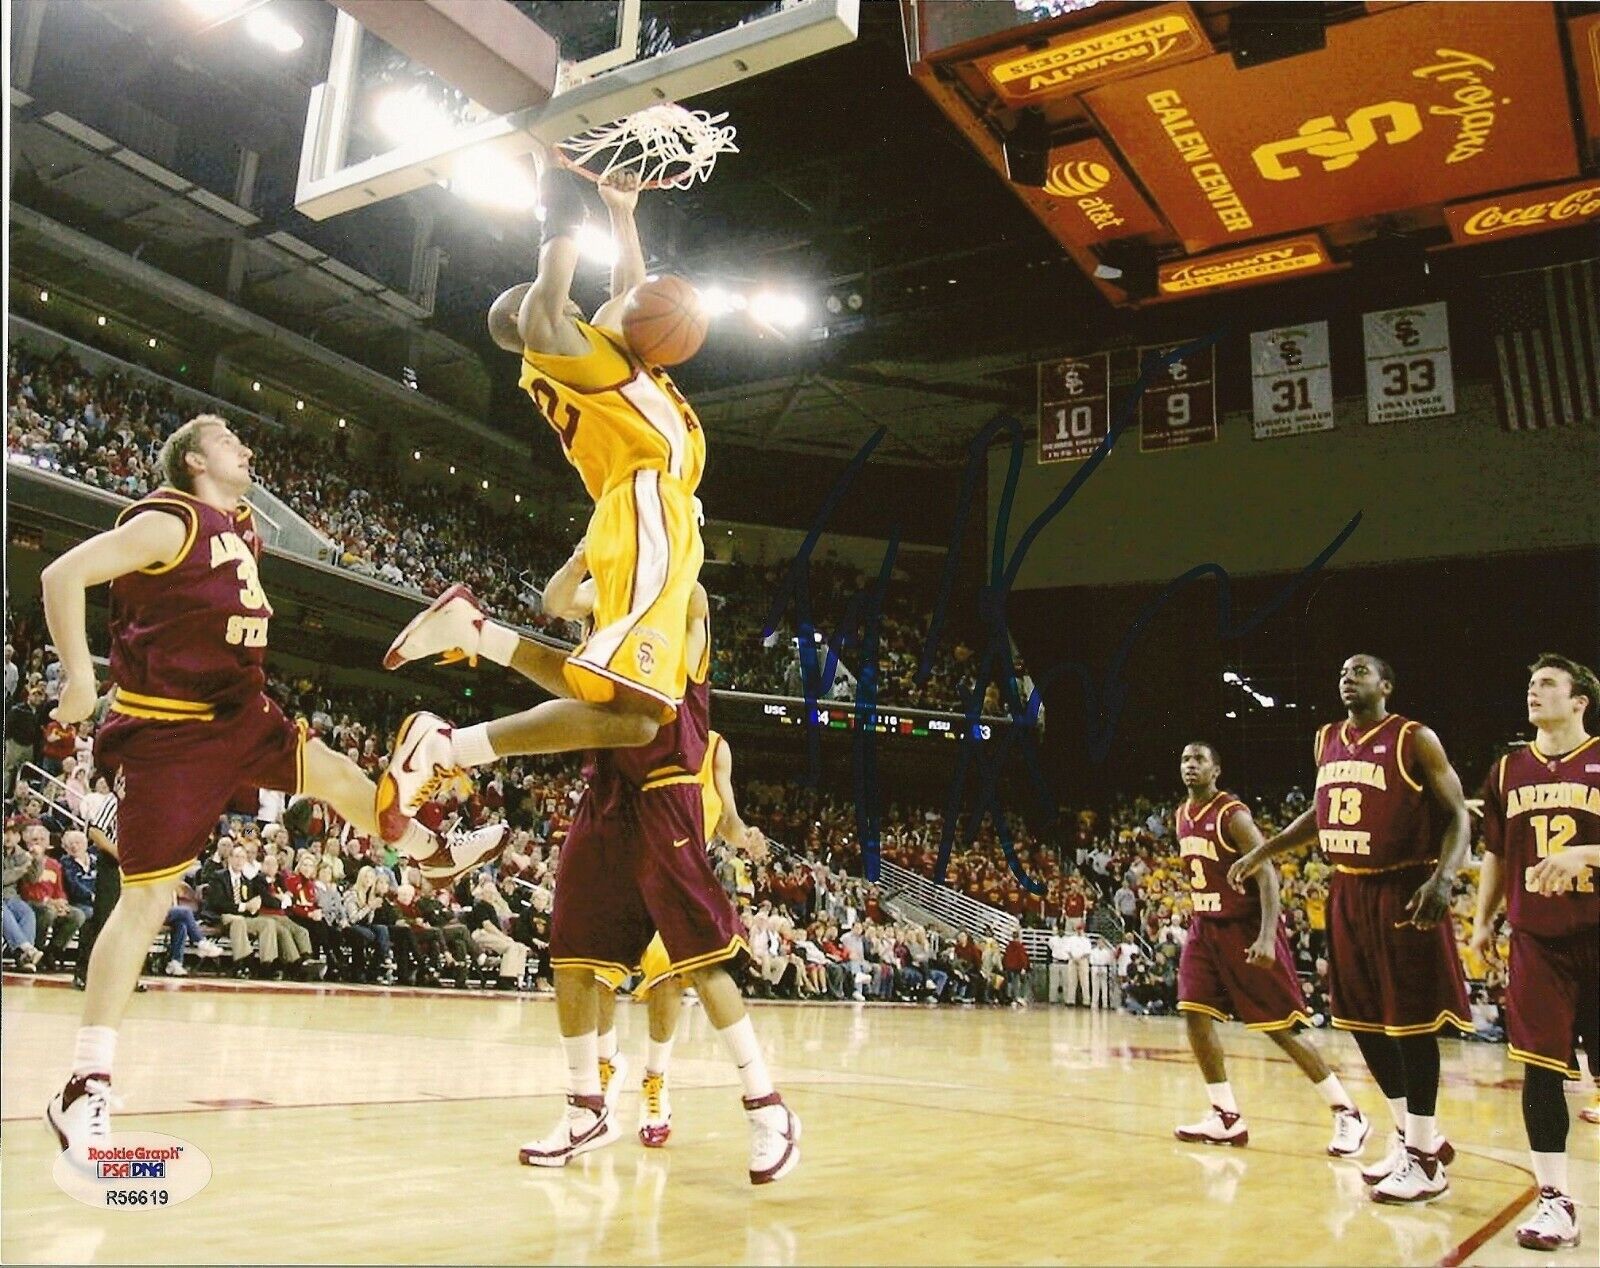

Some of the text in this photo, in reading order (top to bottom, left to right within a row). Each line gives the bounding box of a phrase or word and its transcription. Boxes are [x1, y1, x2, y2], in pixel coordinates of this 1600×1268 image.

[1412, 48, 1511, 164] Trojans
[1146, 89, 1253, 233] GALEN CENTER
[1077, 196, 1125, 231] at&t
[1382, 358, 1436, 396] 33
[1167, 393, 1191, 426] 9
[1271, 377, 1313, 413] 31
[1055, 406, 1092, 440] 10
[764, 704, 787, 716] USC
[1328, 787, 1362, 825] 13
[1530, 814, 1577, 858] 12
[1191, 858, 1207, 889] 3
[102, 1162, 165, 1178] PSA DNA
[106, 1190, 169, 1205] R56619
